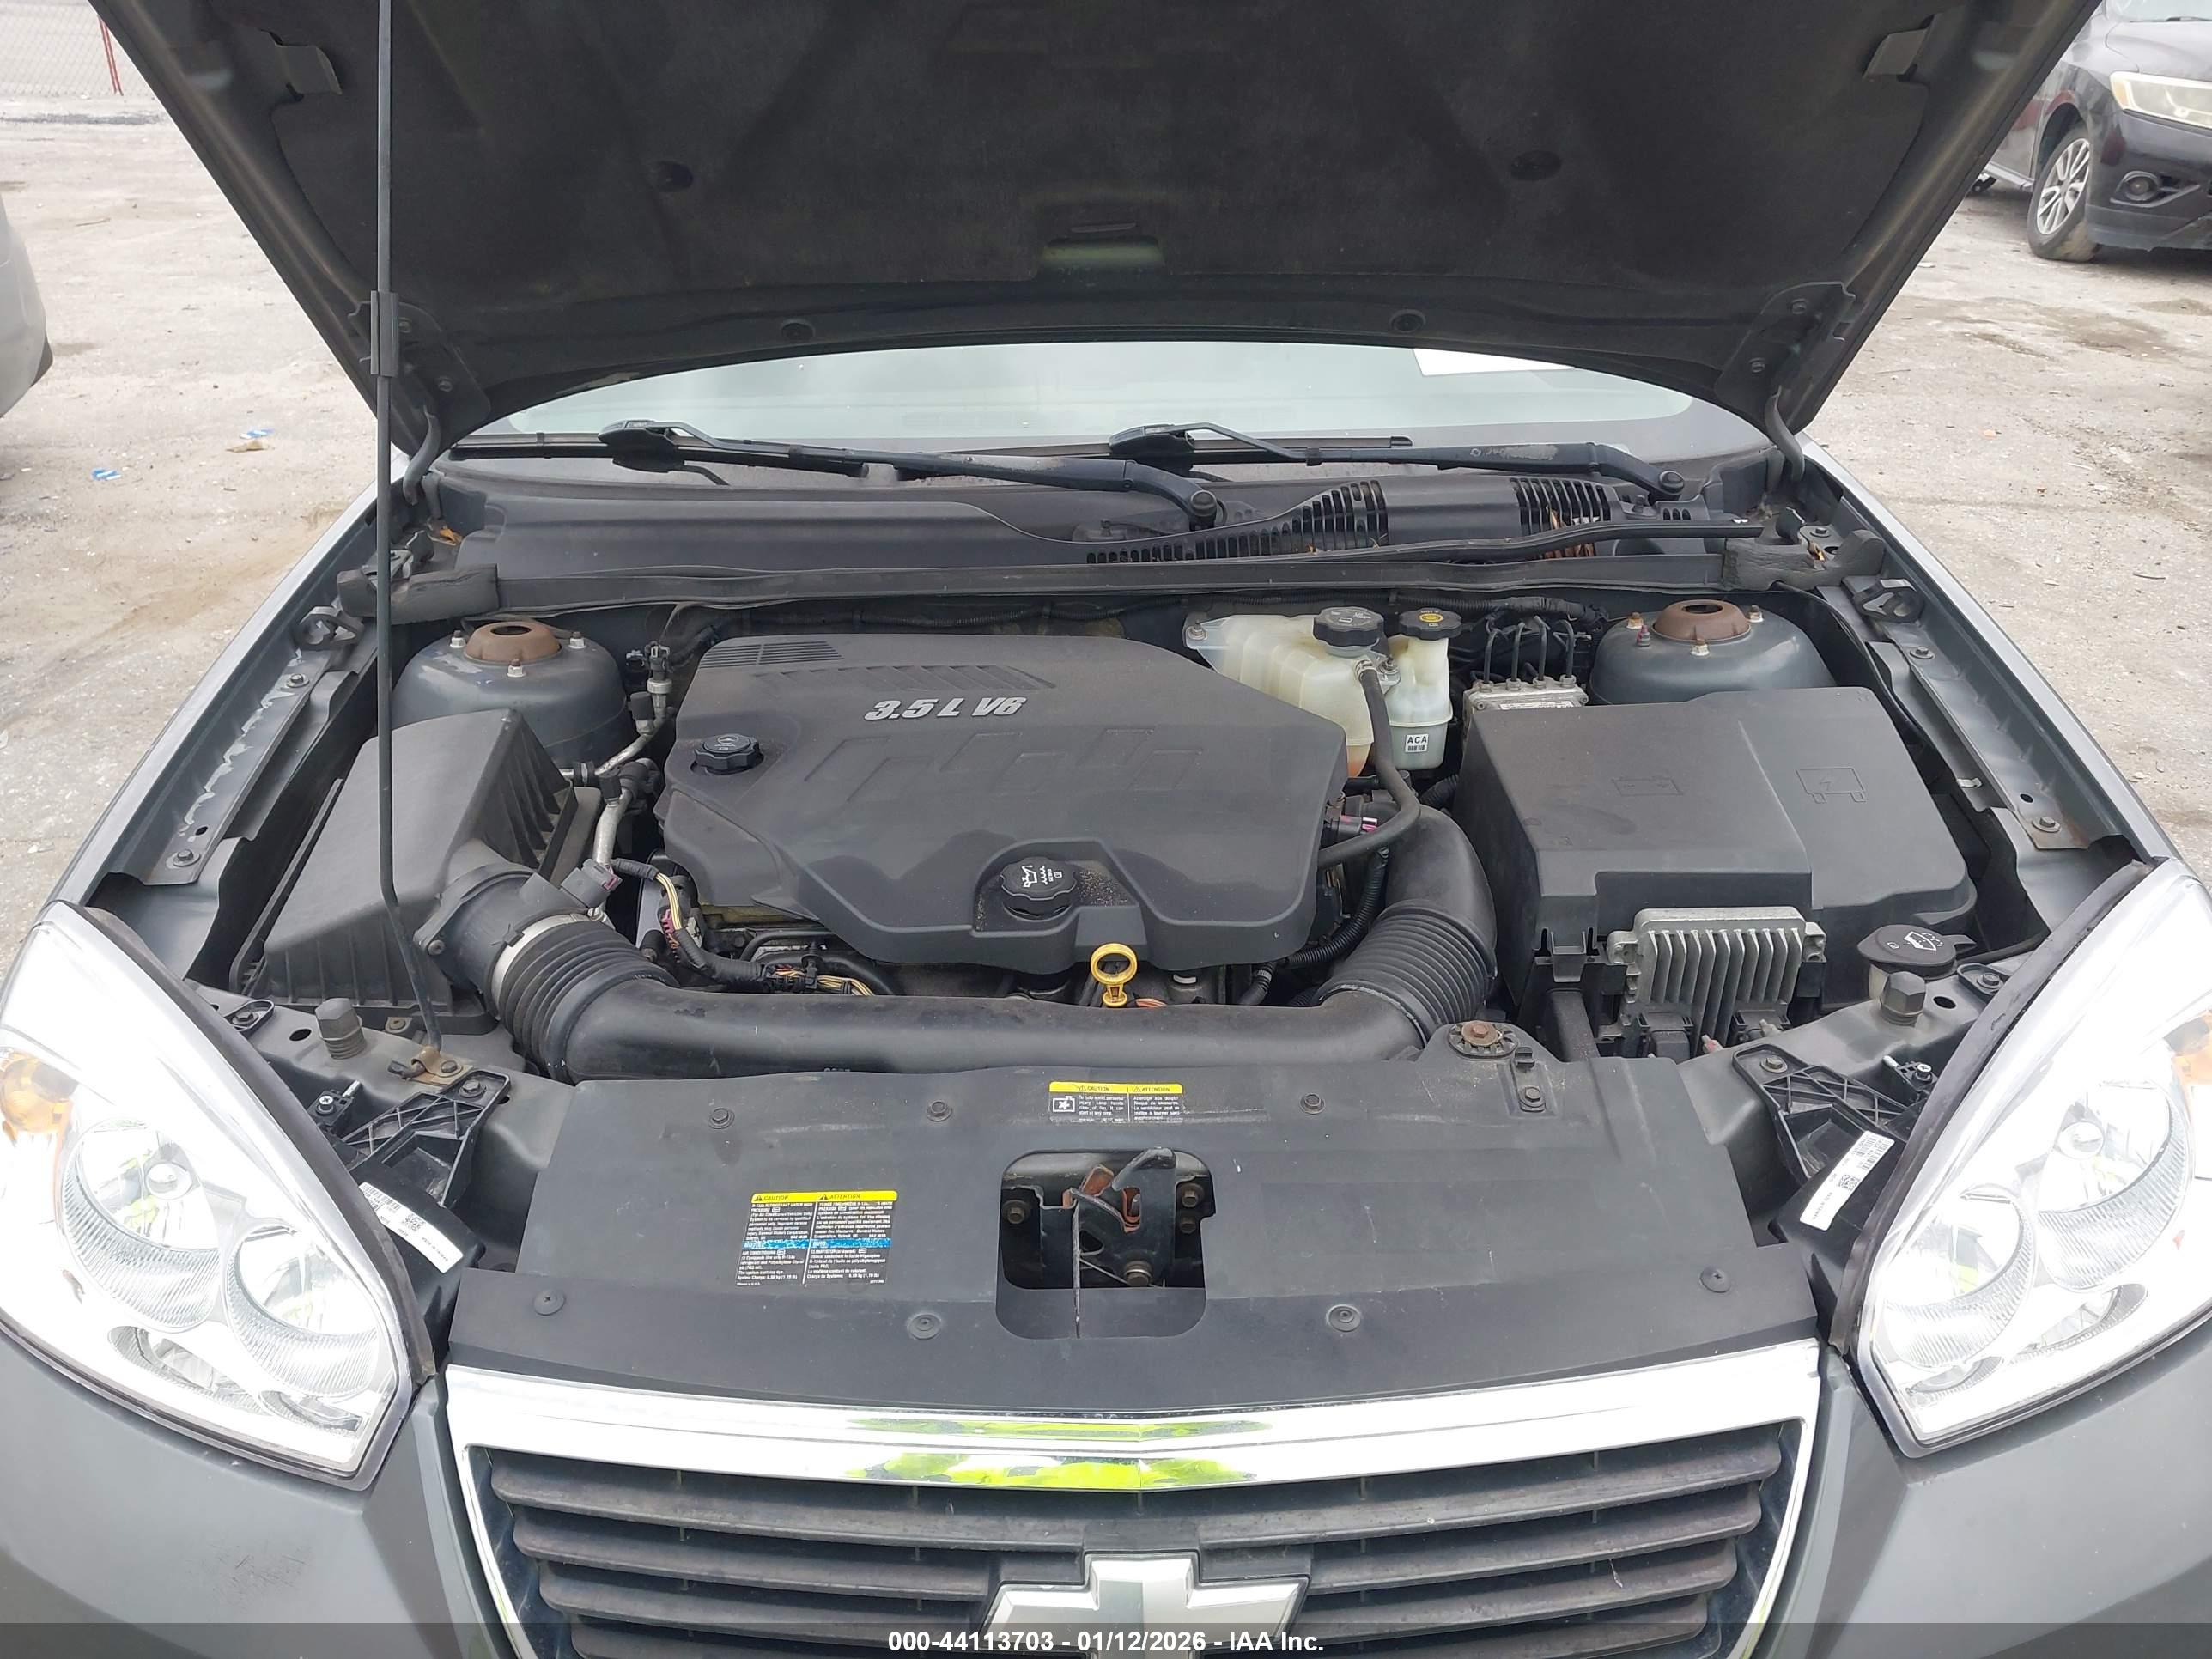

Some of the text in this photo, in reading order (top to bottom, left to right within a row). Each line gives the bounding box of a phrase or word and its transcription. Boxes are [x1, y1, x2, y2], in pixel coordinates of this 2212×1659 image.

[865, 696, 1027, 721] 3.5 L V6
